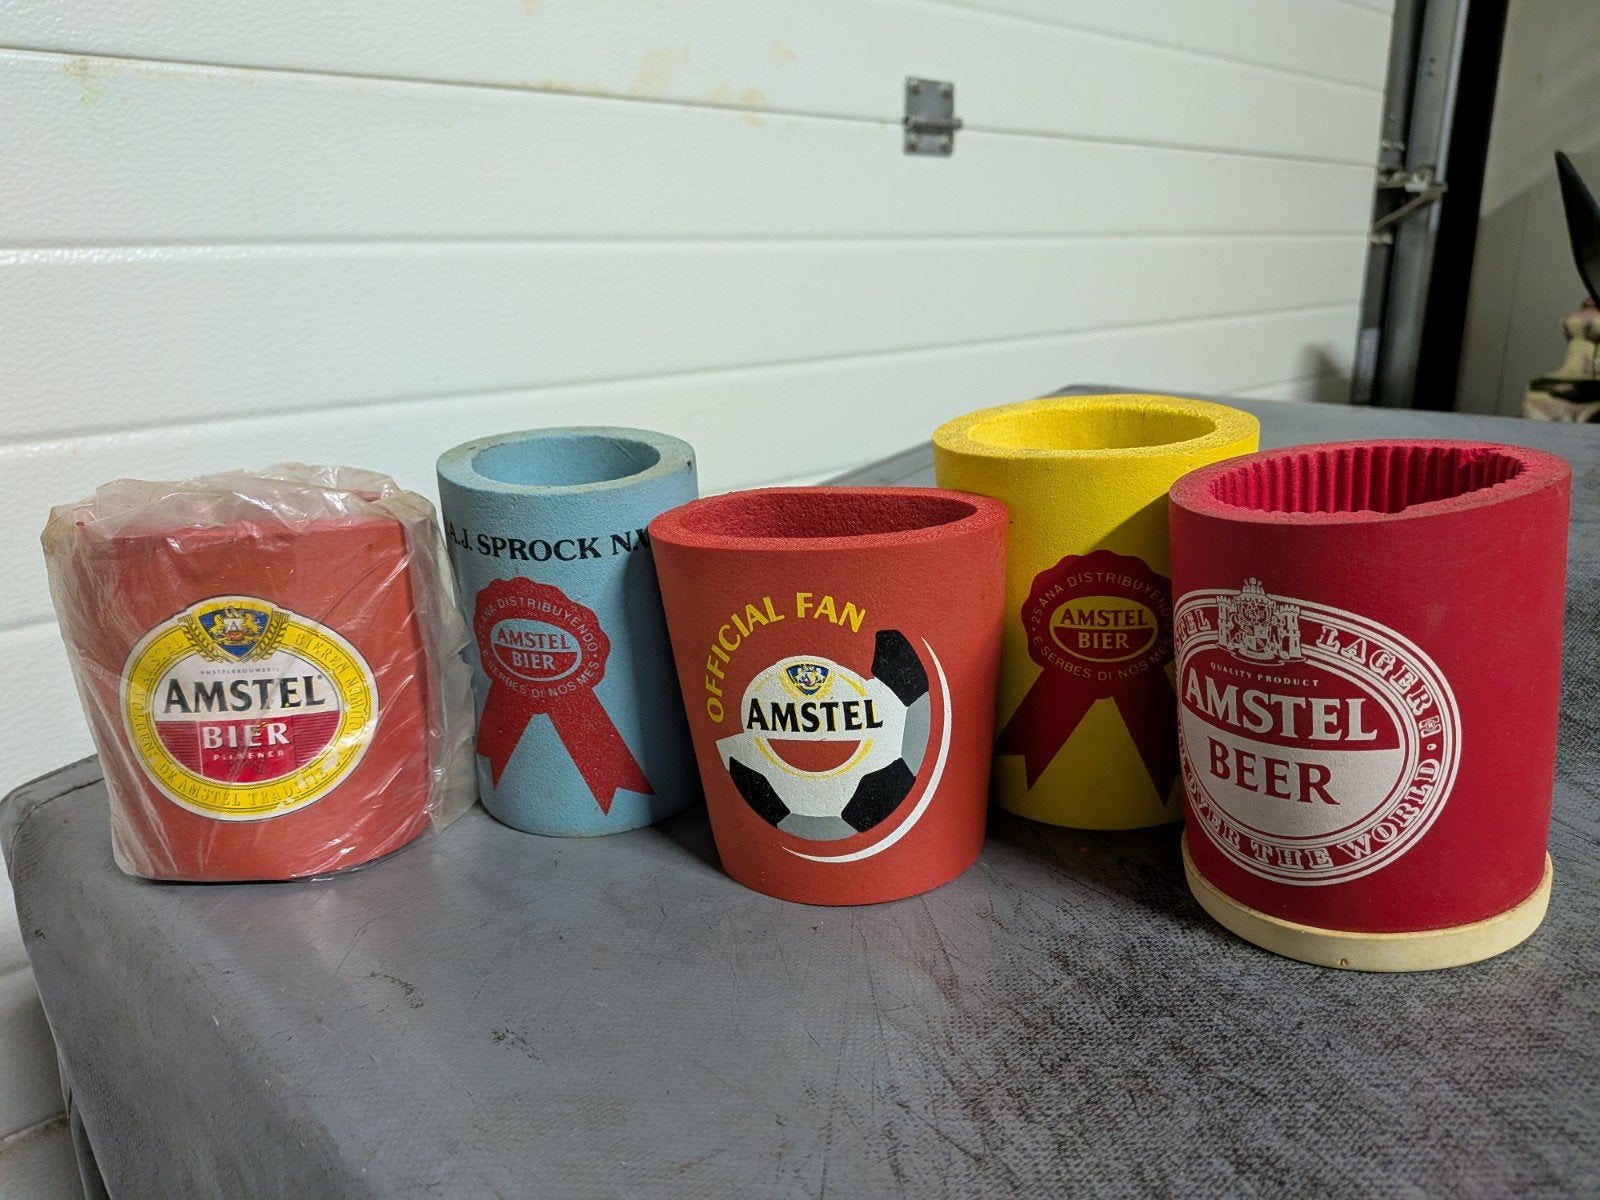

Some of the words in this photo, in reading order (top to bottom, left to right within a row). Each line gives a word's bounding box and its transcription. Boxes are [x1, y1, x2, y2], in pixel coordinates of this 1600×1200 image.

[477, 533, 602, 562] SPROCK
[1031, 608, 1043, 624] 25
[1038, 584, 1064, 607] ANA
[1060, 608, 1150, 627] AMSTEL
[496, 627, 572, 650] AMSTEL
[497, 595, 598, 652] DISTRIBUYENDO
[1077, 631, 1130, 650] BIER
[511, 651, 558, 670] BIER
[705, 596, 785, 724] OFFICIAL
[796, 592, 867, 634] FAN
[1041, 645, 1092, 679] SERBES
[1097, 671, 1112, 681] DI
[1118, 660, 1149, 679] NOS
[1210, 661, 1252, 679] QUALITY
[1257, 673, 1319, 687] PRODUCT
[1316, 625, 1433, 716] LAGER
[163, 675, 327, 714] AMSTEL
[548, 681, 577, 696] NOS
[576, 660, 600, 685] MES
[746, 698, 884, 733] AMSTEL
[1185, 666, 1378, 742] AMSTEL
[202, 722, 291, 750] BIER
[1207, 736, 1341, 806] BEER
[1250, 840, 1334, 870] THE
[1337, 757, 1440, 861] WORLD
